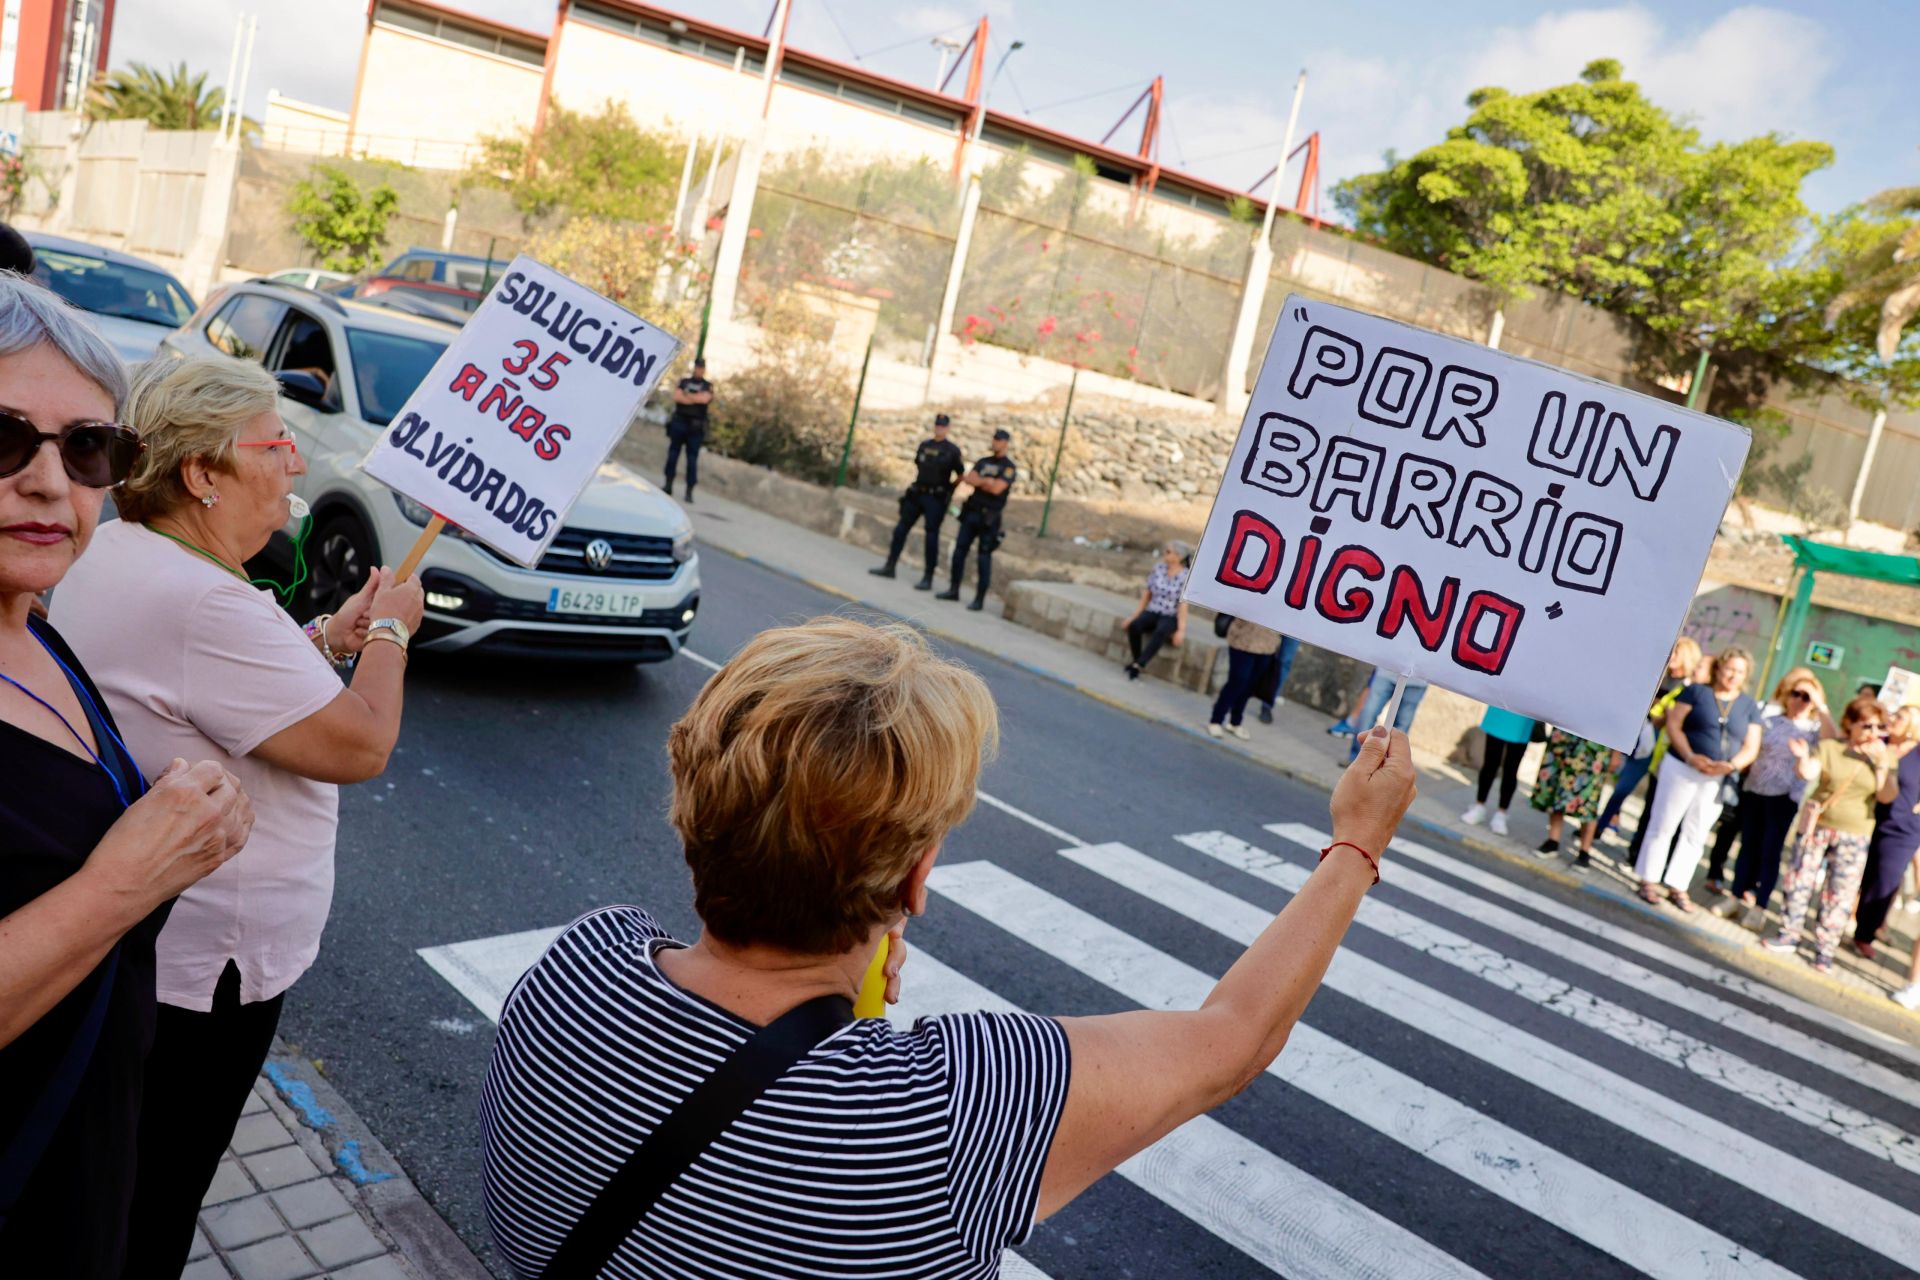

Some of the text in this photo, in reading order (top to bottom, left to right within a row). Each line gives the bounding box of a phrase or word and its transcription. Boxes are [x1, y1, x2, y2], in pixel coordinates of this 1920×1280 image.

[449, 363, 571, 461] AÑOS
[502, 340, 572, 391] 35
[389, 412, 557, 541] OLVIDADOS
[1527, 390, 1681, 502] UN
[1240, 411, 1624, 596] BARRIO
[561, 591, 640, 613] 6429 LTP
